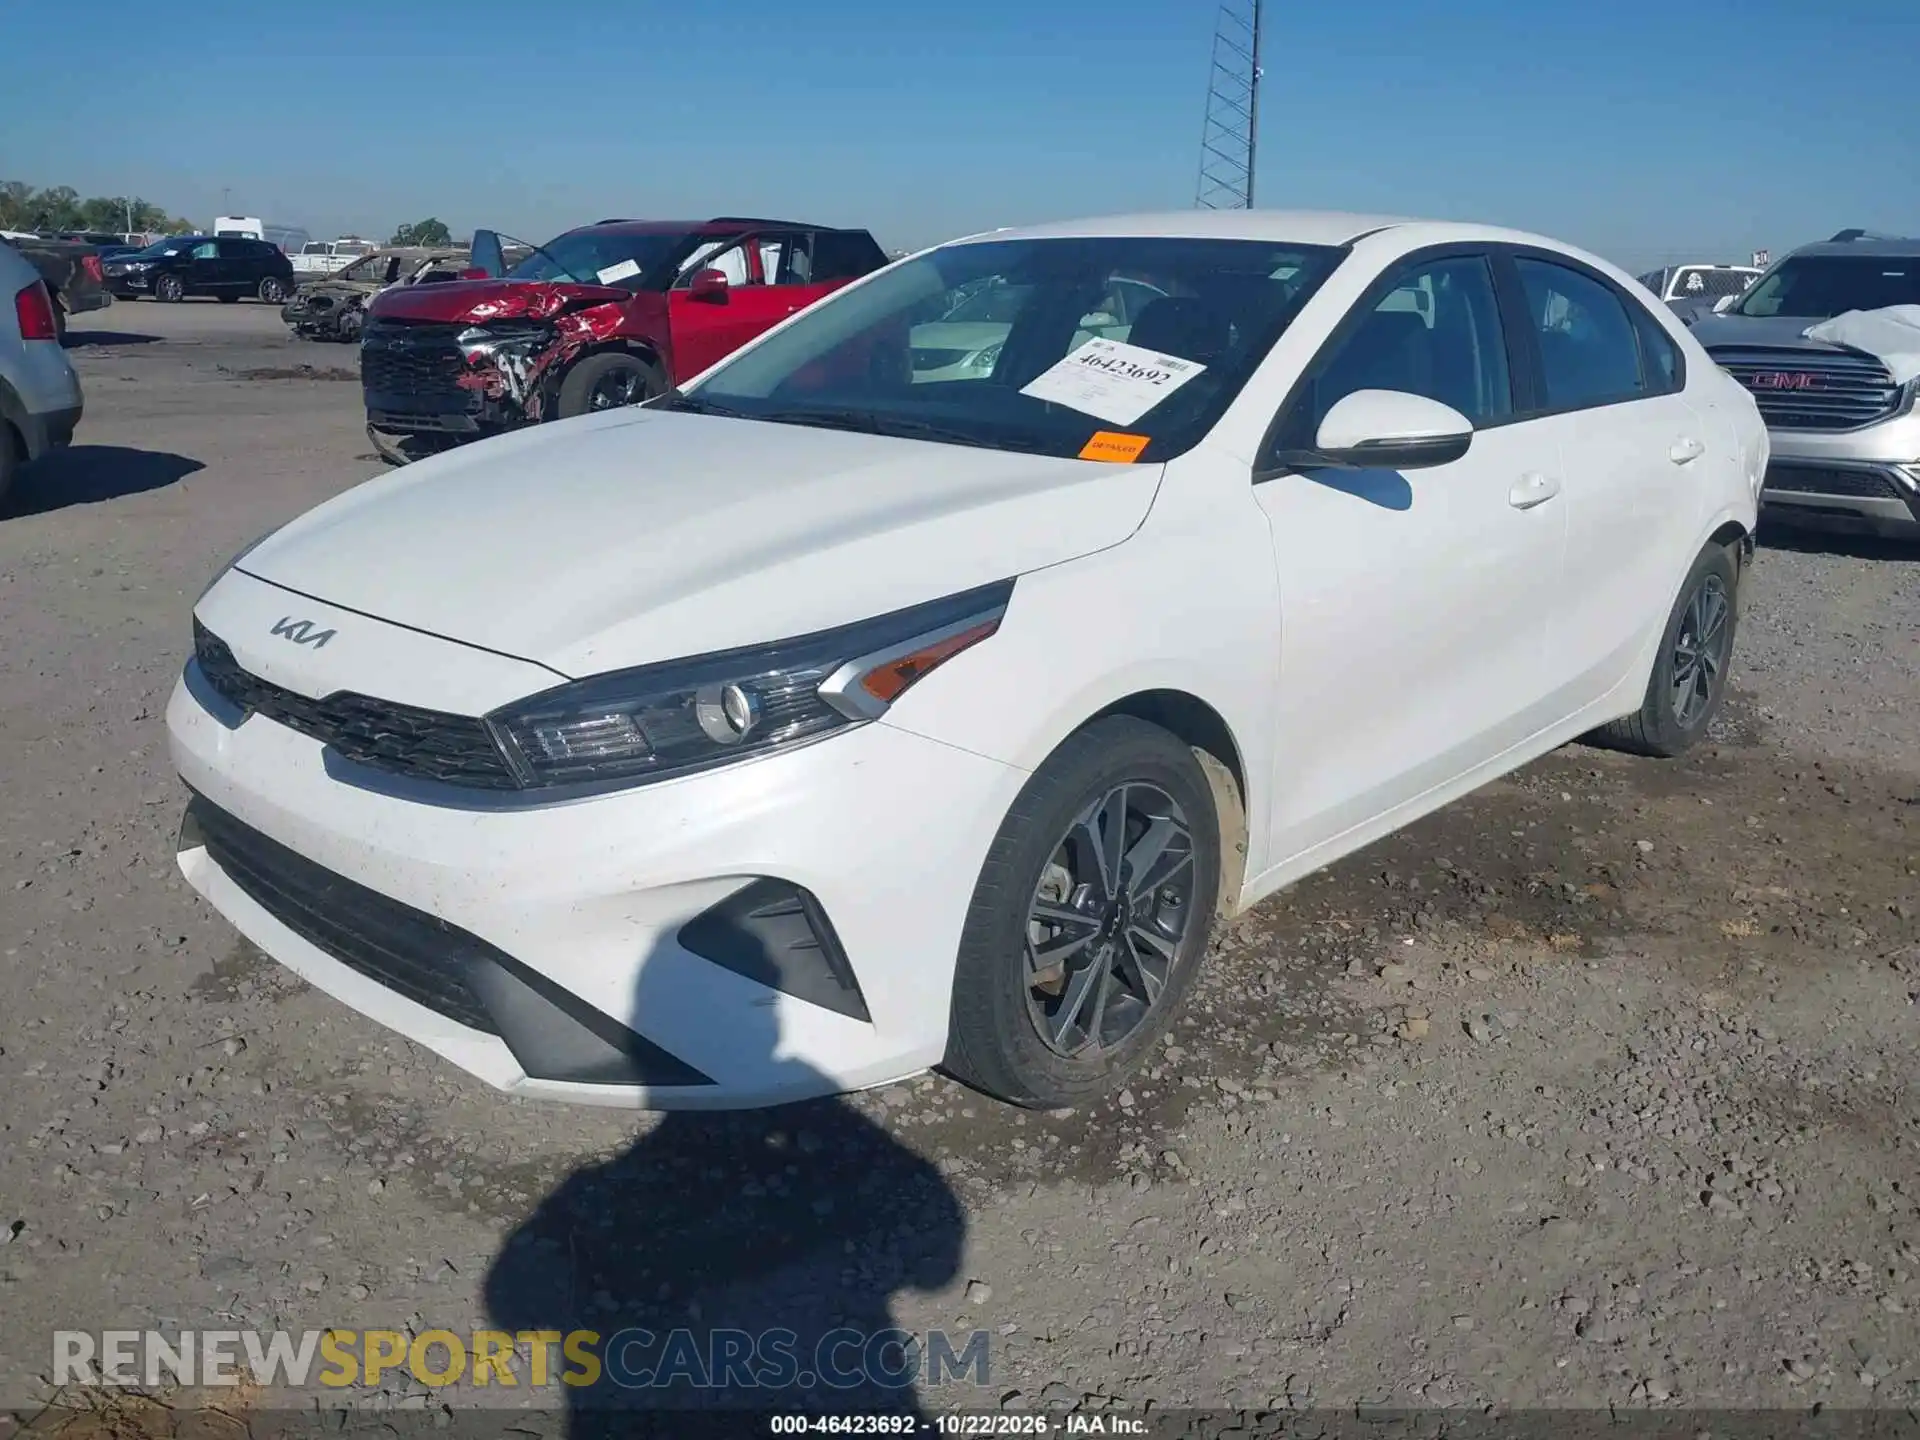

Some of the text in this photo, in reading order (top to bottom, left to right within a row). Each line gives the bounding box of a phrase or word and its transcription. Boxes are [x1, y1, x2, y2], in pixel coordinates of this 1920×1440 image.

[1079, 353, 1172, 385] 46423692
[1751, 371, 1829, 389] GMC
[270, 616, 337, 650] KIA
